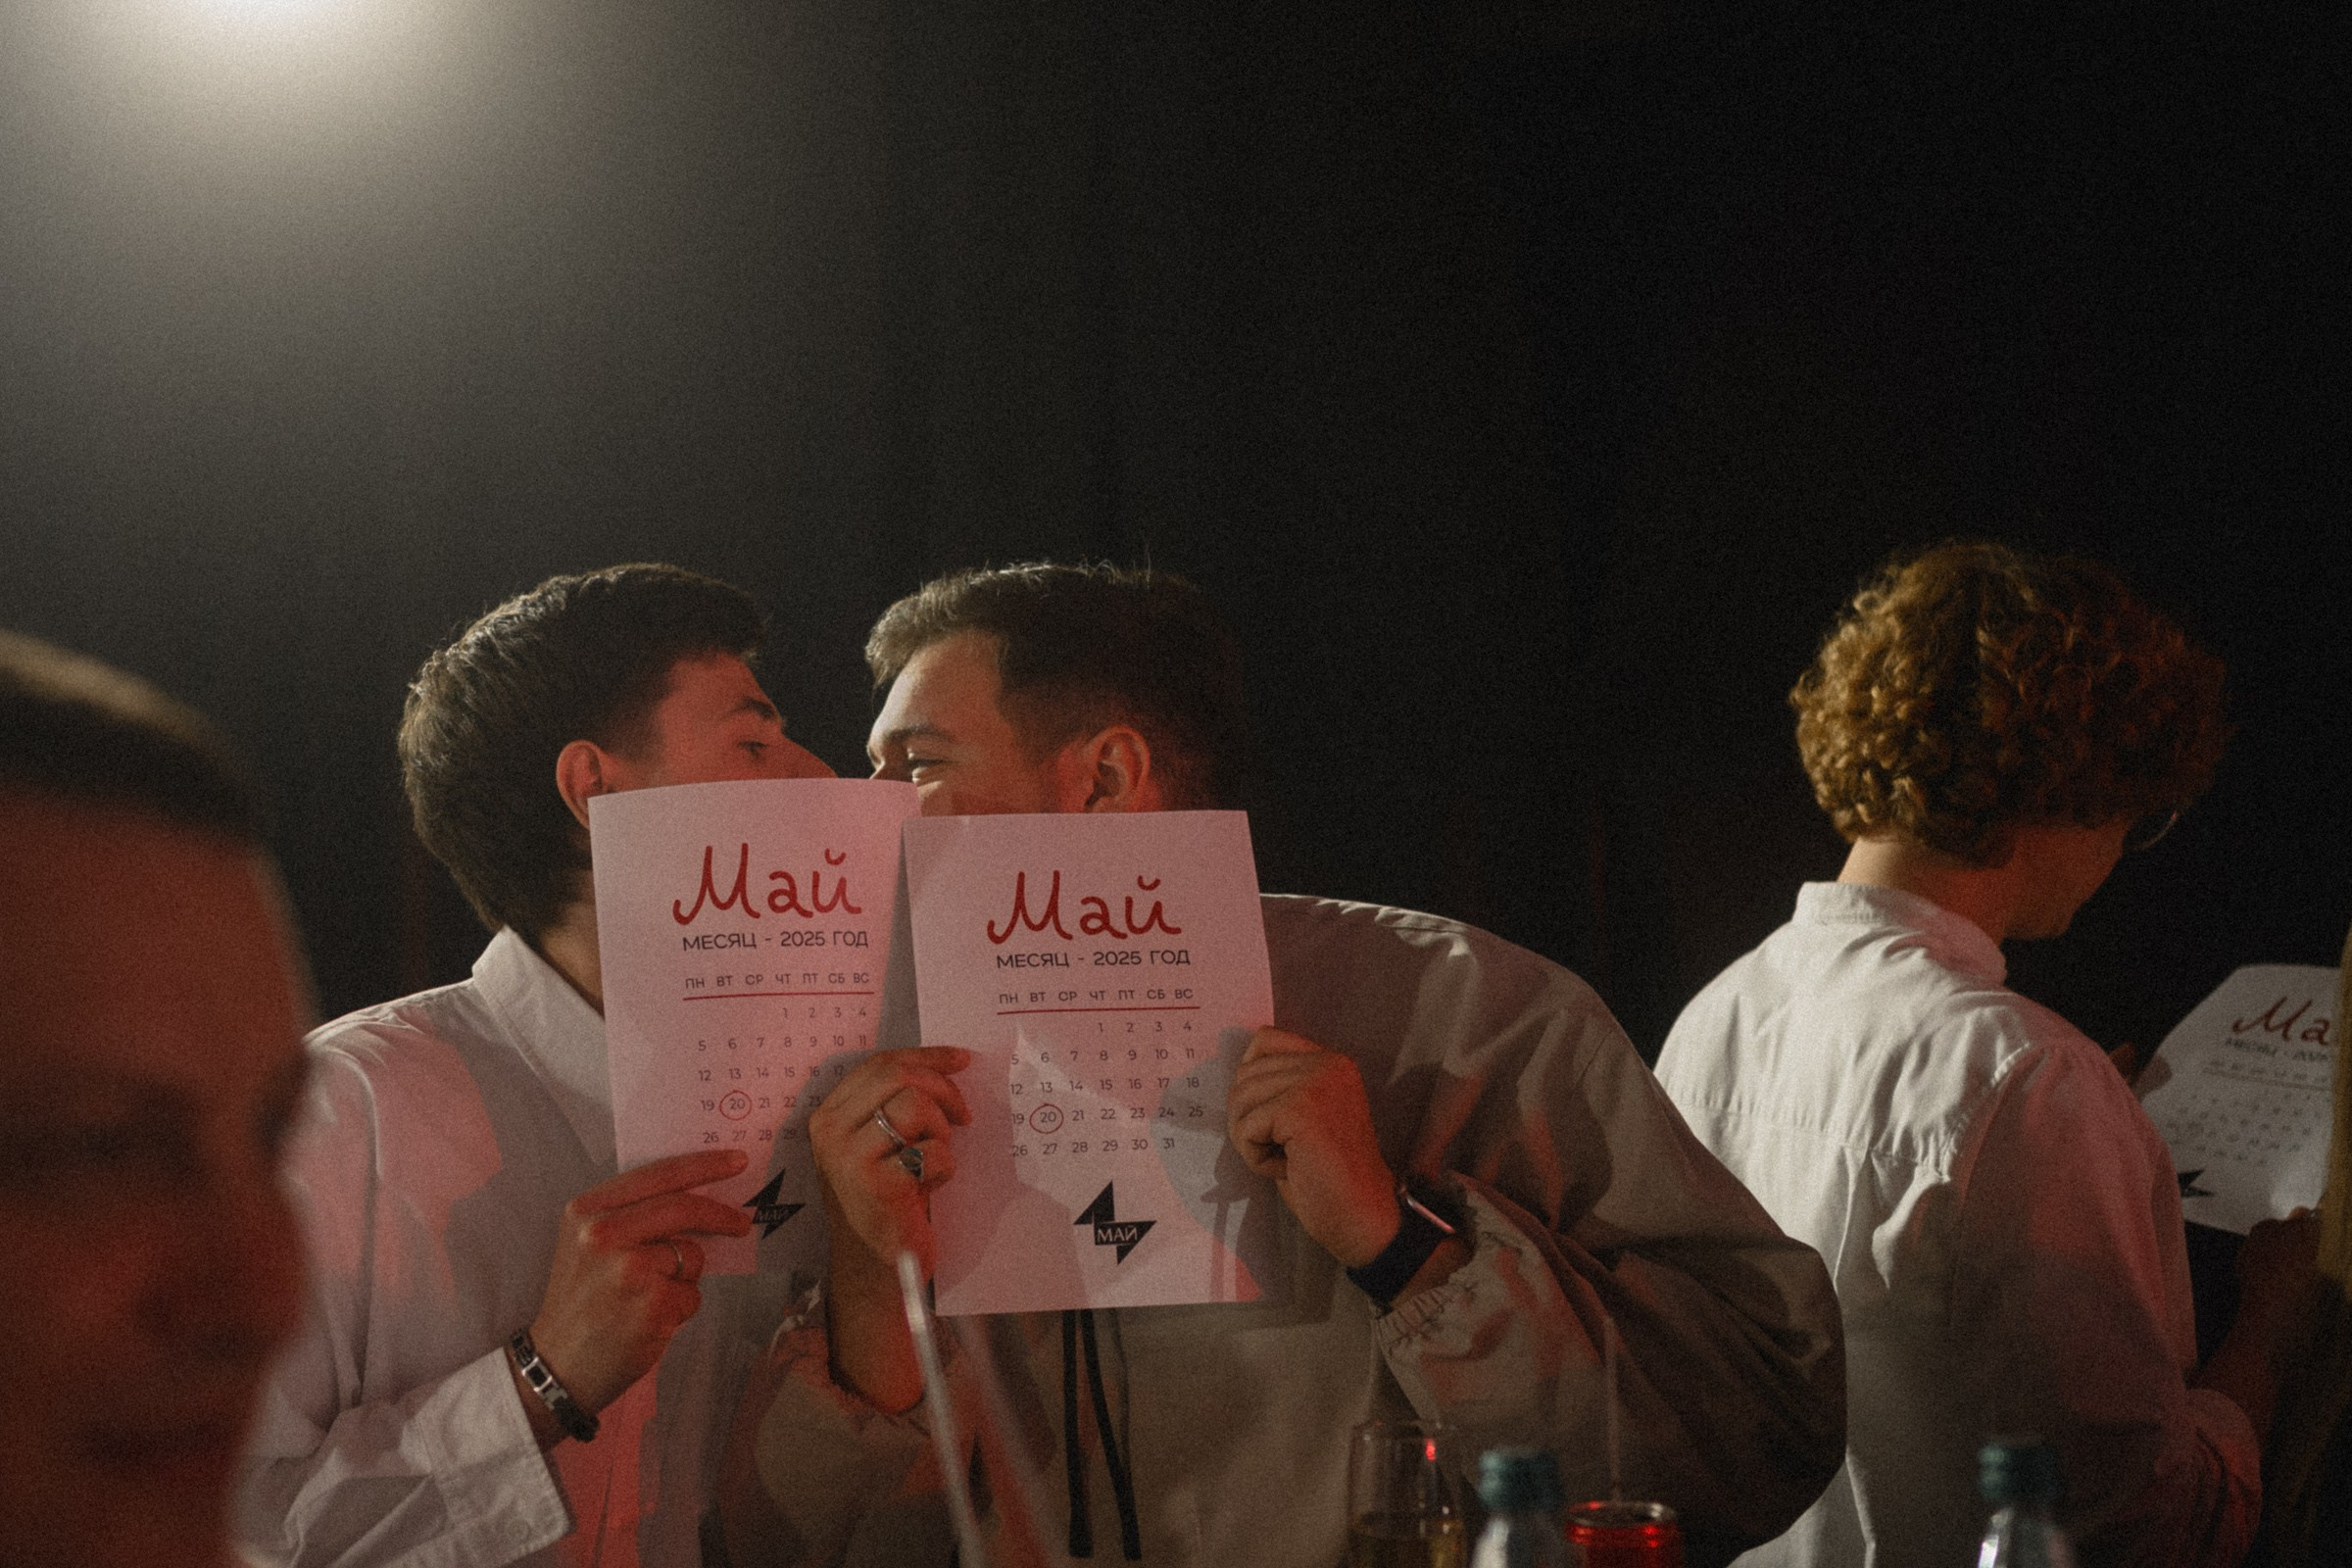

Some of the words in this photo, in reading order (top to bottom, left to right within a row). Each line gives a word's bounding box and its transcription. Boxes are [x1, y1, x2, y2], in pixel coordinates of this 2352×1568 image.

[672, 842, 862, 926] Май
[987, 869, 1182, 945] Май
[682, 932, 757, 952] МЕСЯЦ
[780, 931, 826, 948] 2025
[833, 930, 868, 949] ГОД
[997, 952, 1070, 969] МЕСЯЦ
[1094, 951, 1142, 966] 2025
[1150, 949, 1191, 966] ГОД
[685, 978, 705, 990] ПН
[716, 975, 733, 987] ВТ
[745, 974, 764, 986] СР
[775, 973, 791, 985] ЧТ
[803, 973, 818, 984] ПТ
[828, 973, 846, 984] СБ
[854, 973, 870, 984] ВС
[999, 993, 1018, 1004] ПН
[1030, 992, 1047, 1003] ВТ
[1058, 991, 1077, 1002] СР
[1089, 991, 1107, 1001] ЧТ
[1118, 990, 1135, 1001] ПТ
[1147, 989, 1165, 1000] СБ
[1175, 989, 1194, 1000] ВС
[783, 1007, 788, 1018] 1
[808, 1007, 816, 1018] 2
[834, 1006, 842, 1018] 3
[858, 1006, 867, 1018] 4
[1098, 1022, 1103, 1032] 1
[1126, 1022, 1134, 1032] 2
[1155, 1022, 1163, 1032] 3
[1183, 1021, 1192, 1031] 4
[2231, 996, 2330, 1047] Ма
[698, 1040, 707, 1052] 5
[728, 1038, 737, 1050] 6
[757, 1037, 765, 1048] 7
[784, 1037, 792, 1048] 8
[809, 1036, 817, 1048] 9
[833, 1036, 845, 1047] 10
[858, 1036, 867, 1046] 11
[1010, 1054, 1019, 1065] 5
[1041, 1053, 1050, 1063] 6
[1069, 1052, 1078, 1061] 7
[1100, 1051, 1108, 1060] 8
[1128, 1050, 1137, 1060] 9
[1155, 1049, 1168, 1059] 10
[1186, 1049, 1195, 1058] 11
[698, 1070, 711, 1082] 12
[728, 1068, 742, 1079] 13
[756, 1067, 769, 1078] 14
[784, 1067, 795, 1078] 15
[808, 1066, 820, 1077] 16
[1010, 1084, 1024, 1096] 12
[1040, 1082, 1054, 1093] 13
[1069, 1080, 1083, 1092] 14
[1101, 1080, 1113, 1091] 15
[1129, 1079, 1142, 1090] 16
[1158, 1078, 1170, 1089] 17
[1187, 1077, 1200, 1088] 18
[701, 1100, 715, 1111] 19
[729, 1099, 746, 1109] 20
[759, 1098, 770, 1108] 21
[783, 1097, 798, 1108] 22
[1010, 1113, 1025, 1125] 19
[1040, 1111, 1056, 1122] 20
[1072, 1110, 1085, 1121] 21
[1101, 1109, 1116, 1120] 22
[1130, 1108, 1146, 1119] 23
[1158, 1107, 1175, 1118] 24
[1188, 1106, 1203, 1117] 25
[703, 1132, 719, 1144] 26
[732, 1130, 747, 1142] 27
[759, 1129, 773, 1141] 28
[1012, 1146, 1028, 1156] 26
[1043, 1144, 1057, 1154] 27
[1072, 1142, 1088, 1152] 28
[1102, 1141, 1118, 1152] 29
[1131, 1140, 1149, 1151] 30
[1163, 1138, 1175, 1149] 31
[1096, 1223, 1139, 1243] МАЙ
